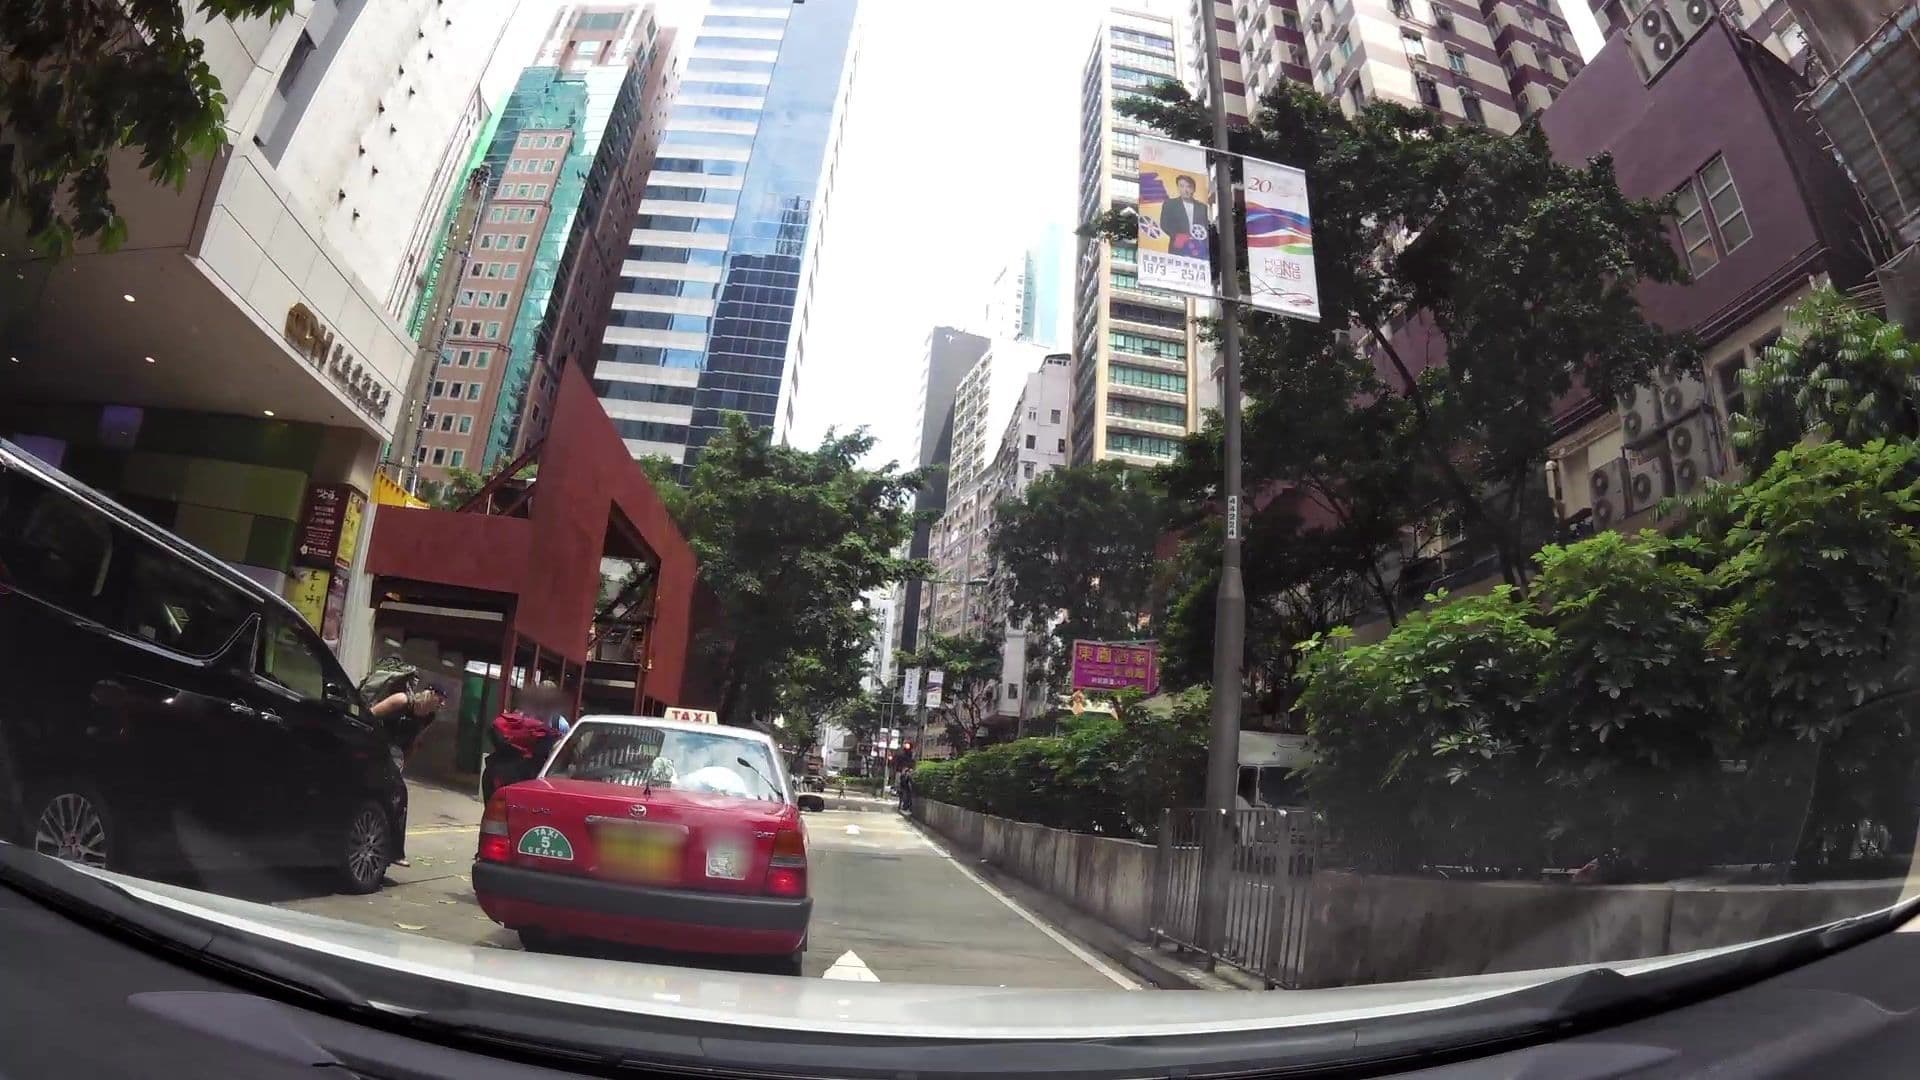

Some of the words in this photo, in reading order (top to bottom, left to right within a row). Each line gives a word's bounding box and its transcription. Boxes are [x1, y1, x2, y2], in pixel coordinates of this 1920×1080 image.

[1247, 176, 1272, 193] 20
[1264, 257, 1301, 271] HONG
[1264, 265, 1302, 280] KONG
[671, 710, 710, 724] TAXI
[534, 828, 559, 839] TAXI
[541, 836, 551, 849] 5
